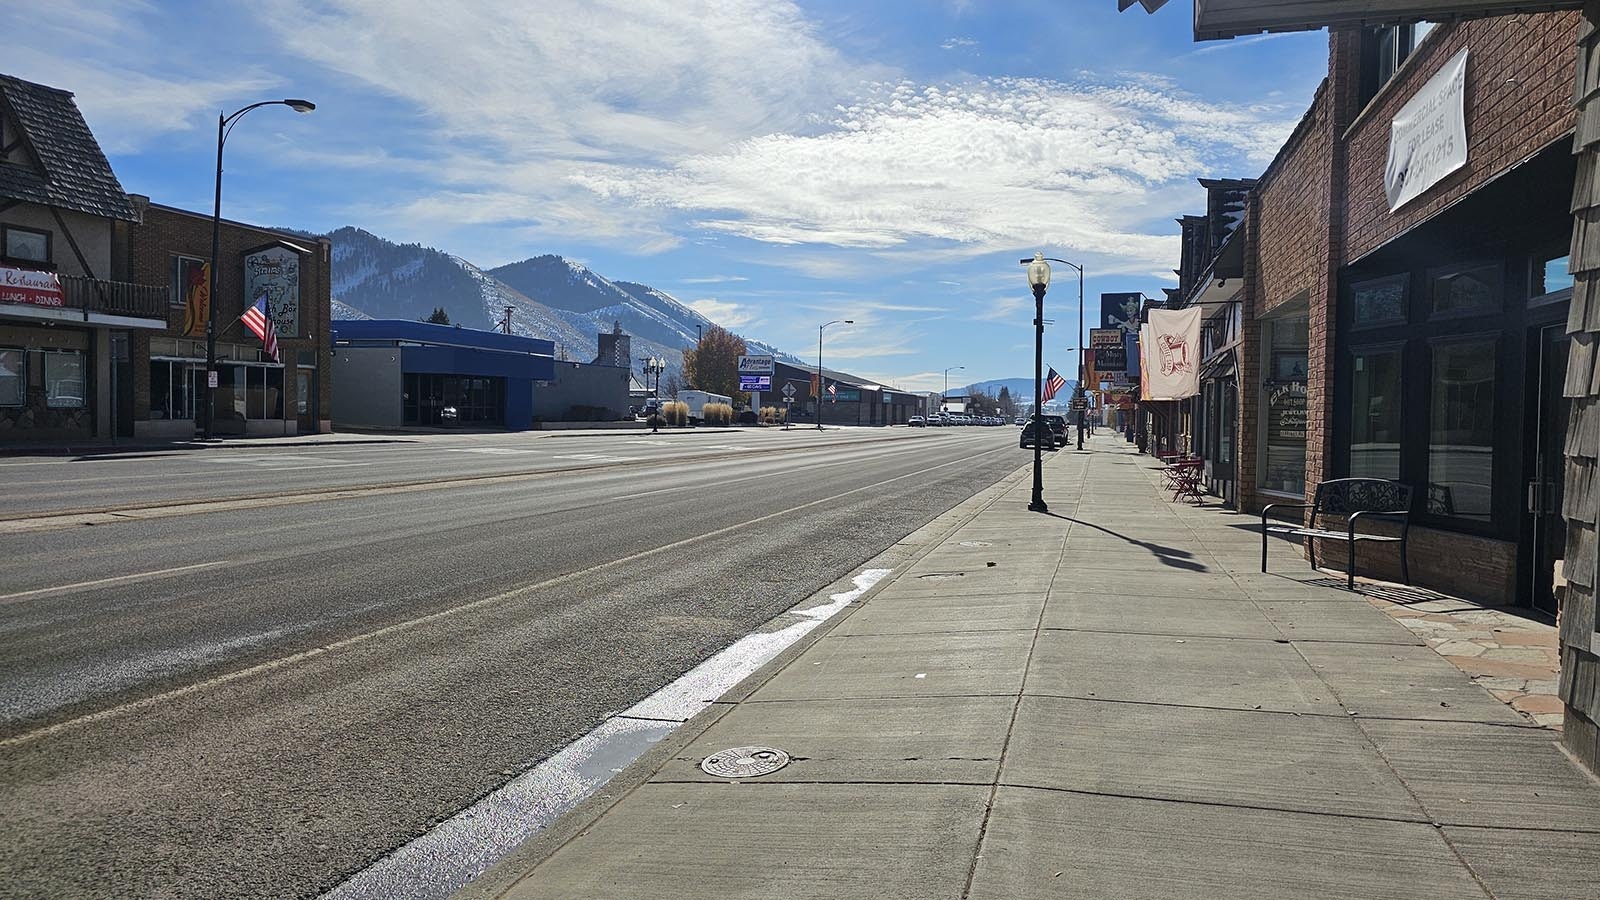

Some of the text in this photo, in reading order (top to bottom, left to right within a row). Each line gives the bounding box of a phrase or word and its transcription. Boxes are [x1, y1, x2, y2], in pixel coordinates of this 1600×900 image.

[1394, 72, 1463, 145] COMMERCIAL SPACE
[1408, 114, 1445, 154] FOR LEASE
[2, 292, 62, 306] LUNCH DINNER
[1093, 335, 1119, 343] COWBOY
[1270, 385, 1289, 407] ELK
